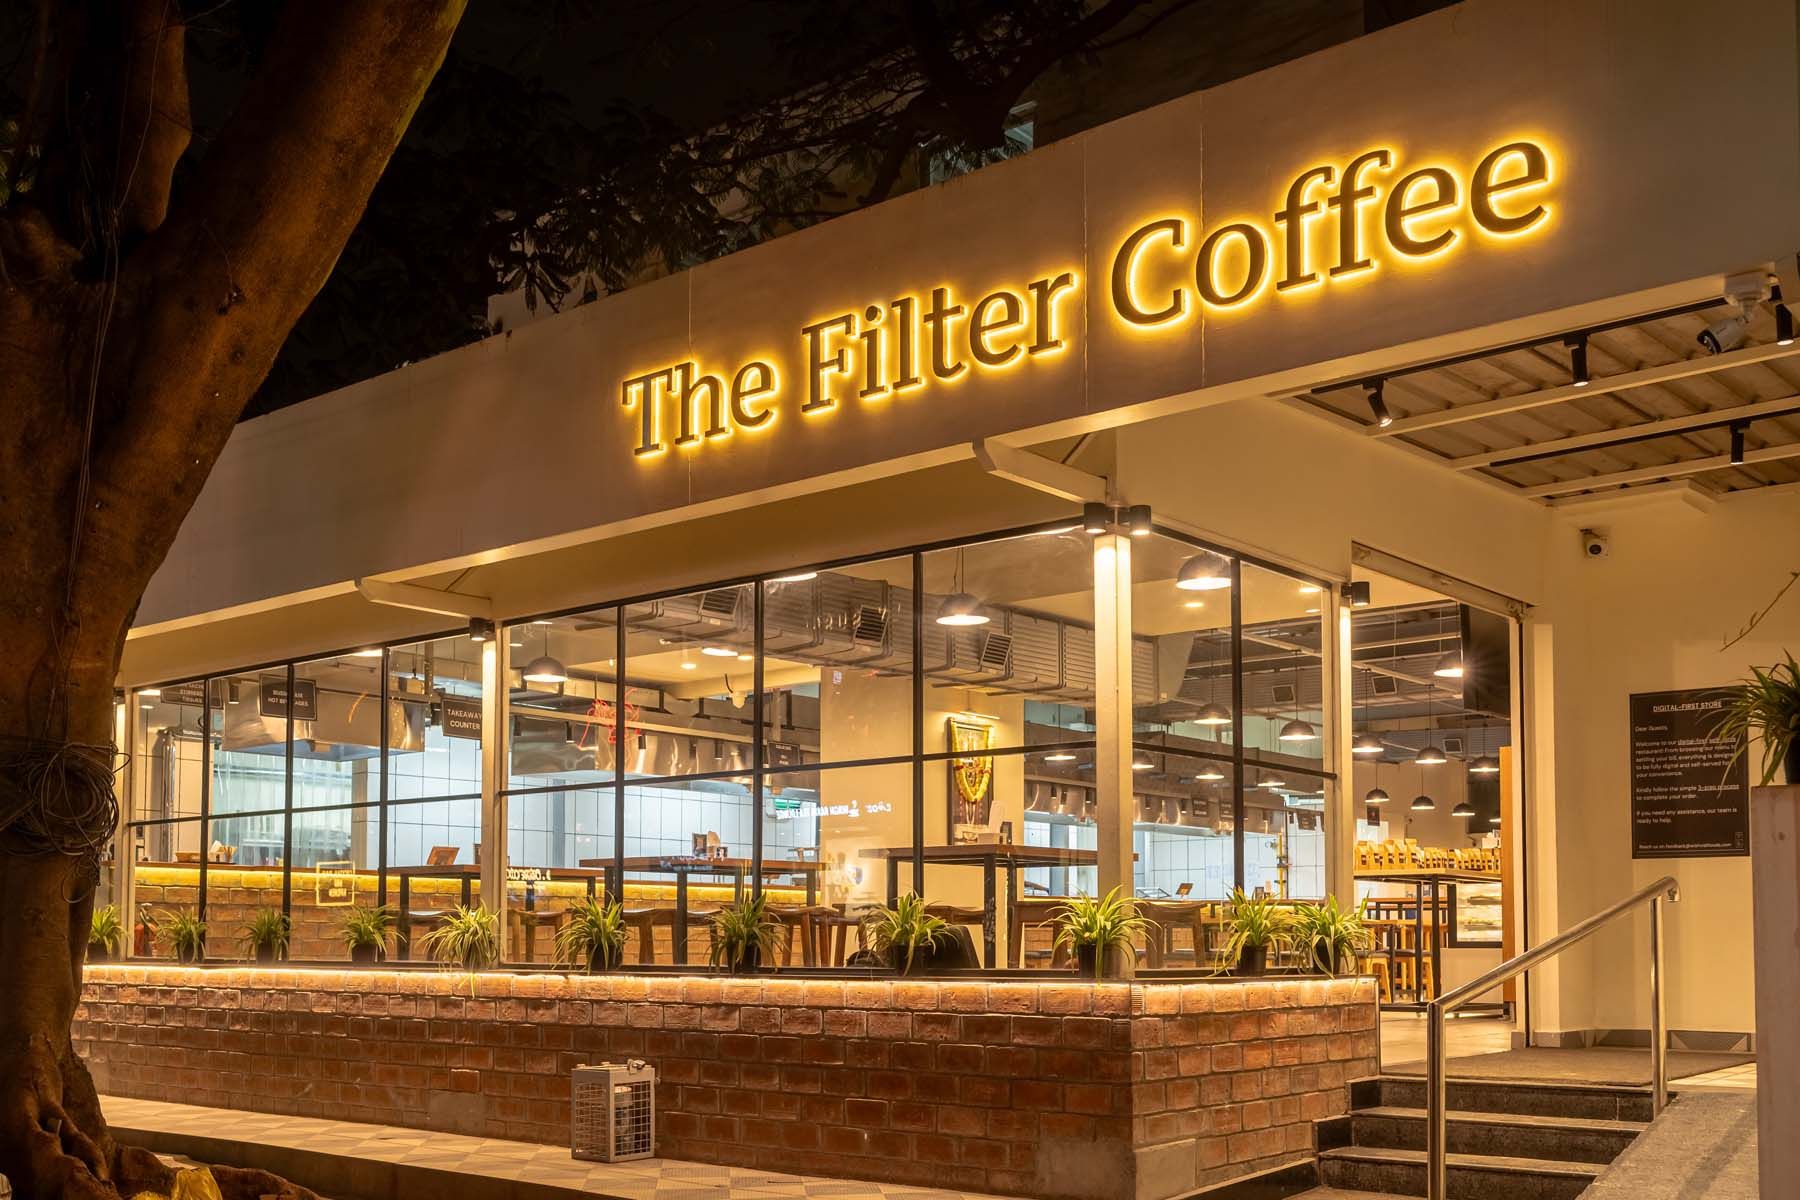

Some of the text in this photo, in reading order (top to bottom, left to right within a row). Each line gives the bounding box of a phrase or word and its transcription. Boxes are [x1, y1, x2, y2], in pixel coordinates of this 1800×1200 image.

[622, 141, 1553, 456] The Filter Coffee
[1700, 700, 1722, 709] STORE
[447, 708, 482, 719] TAKEAWAY
[449, 719, 481, 730] COUNTER
